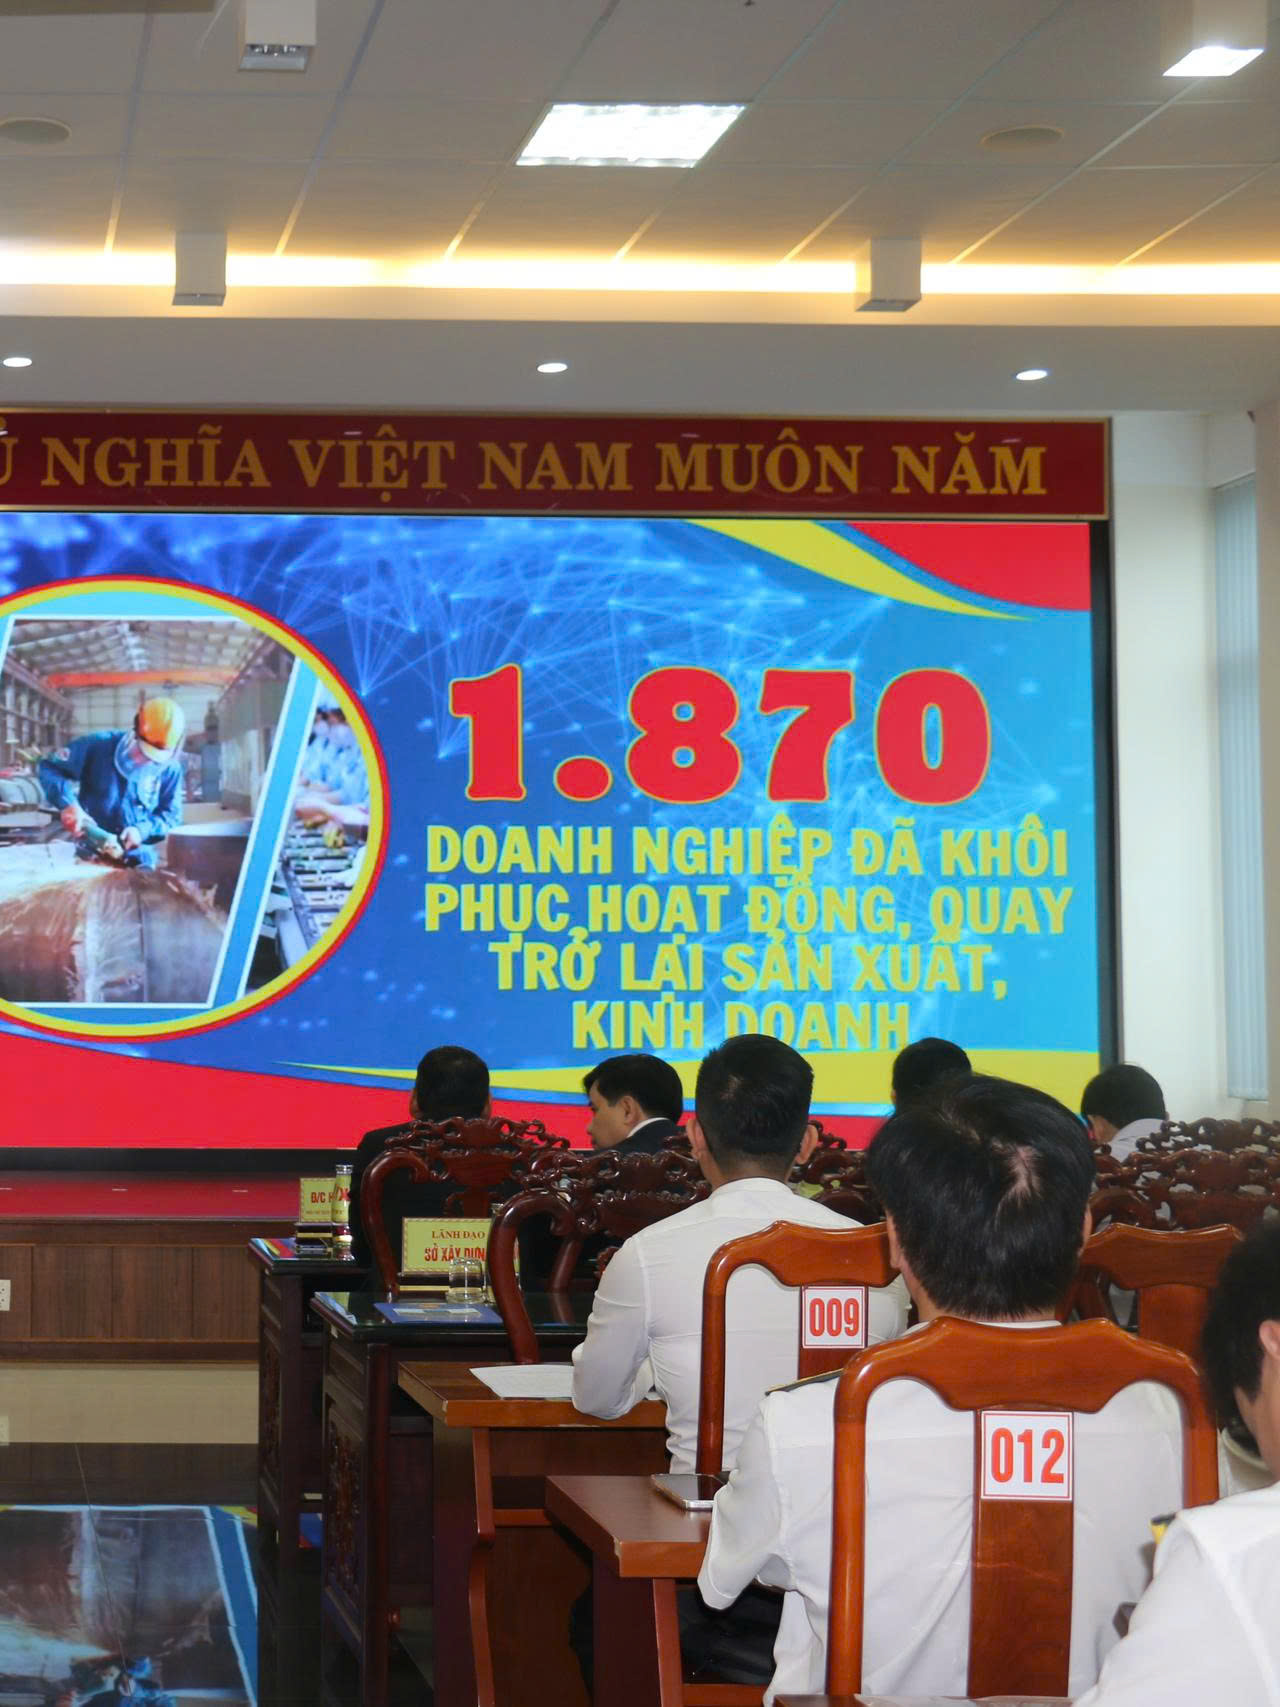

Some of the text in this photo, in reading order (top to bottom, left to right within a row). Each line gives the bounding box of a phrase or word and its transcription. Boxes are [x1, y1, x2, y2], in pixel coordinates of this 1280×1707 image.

[40, 424, 271, 488] NGHĨA
[288, 424, 456, 503] VIỆT
[477, 442, 633, 491] NAM
[656, 427, 864, 494] MUÔN
[892, 431, 1047, 496] NĂM
[449, 663, 991, 806] 1.870
[426, 813, 1068, 887] DOANH NGHIỆP ĐÃ KHÔI
[929, 886, 1073, 940] QUAY
[488, 926, 602, 991] TRỞ
[721, 927, 833, 993] SẢN
[572, 1001, 910, 1050] KINH DOANH
[809, 1297, 860, 1337] 009
[991, 1427, 1065, 1484] 012
